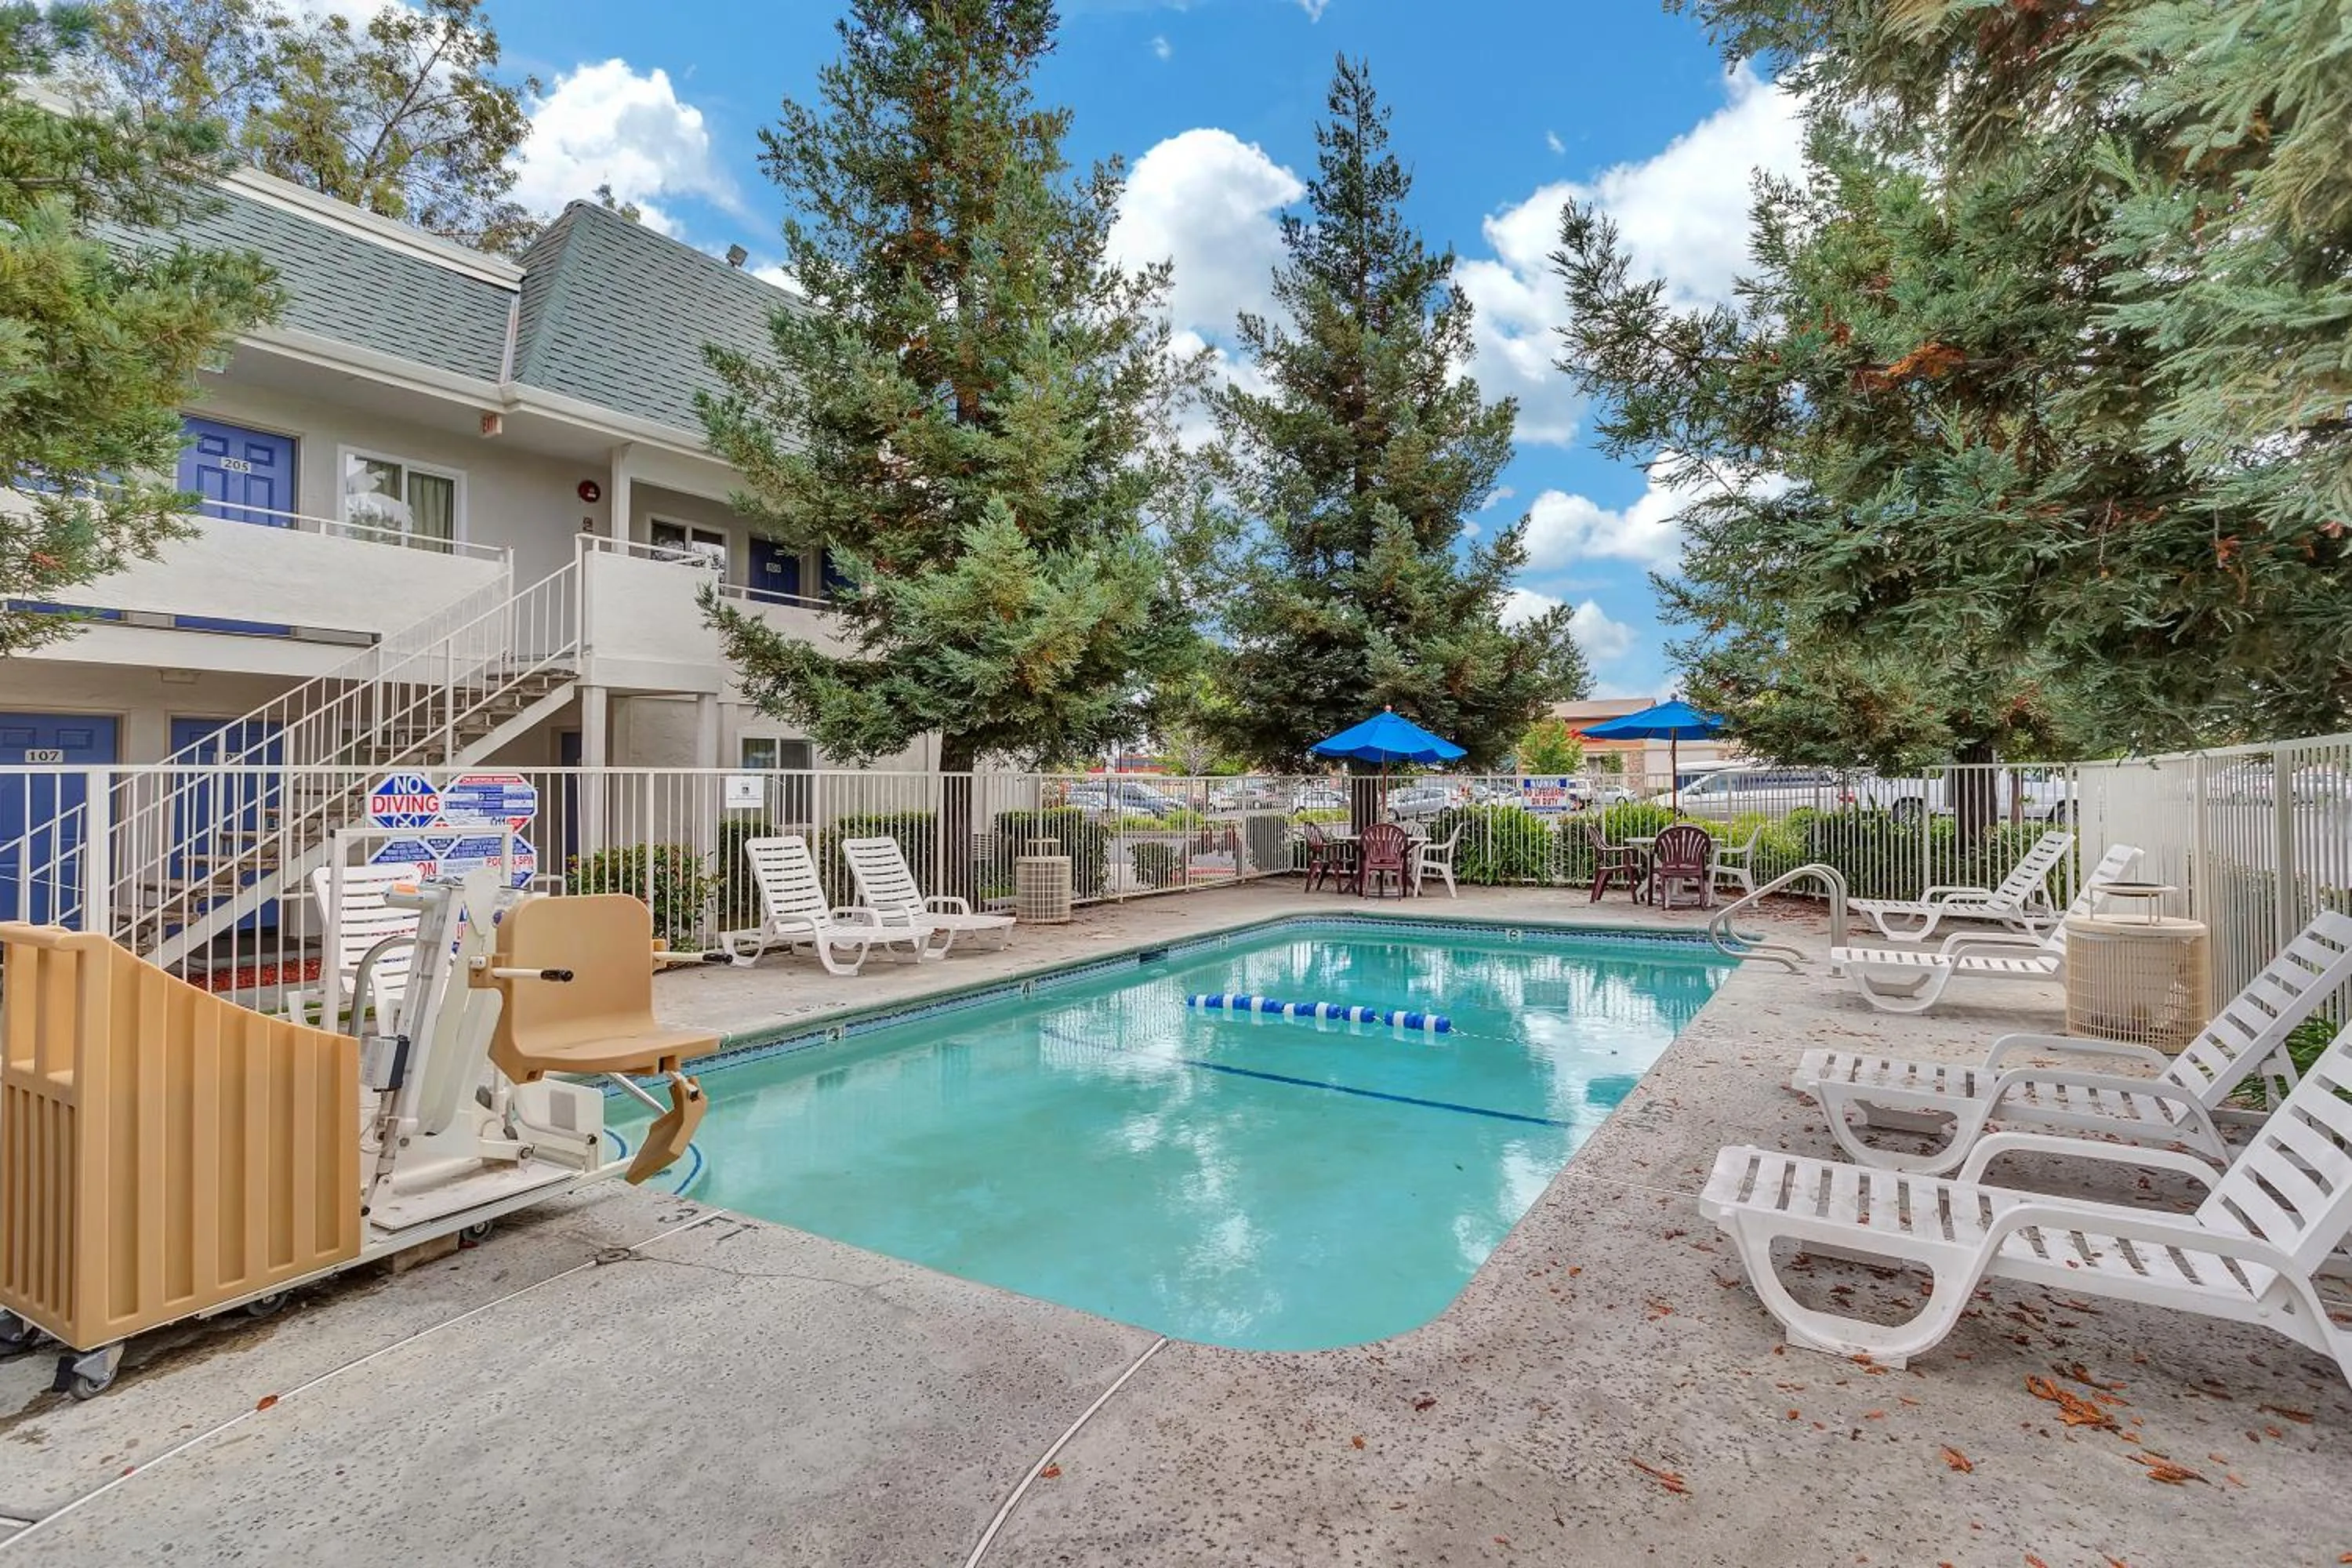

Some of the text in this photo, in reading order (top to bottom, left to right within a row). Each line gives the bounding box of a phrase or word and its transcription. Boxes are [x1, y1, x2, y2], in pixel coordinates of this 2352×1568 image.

[224, 459, 249, 471] 205
[30, 750, 60, 761] 107
[394, 776, 422, 794] NO
[372, 795, 439, 813] DIVING
